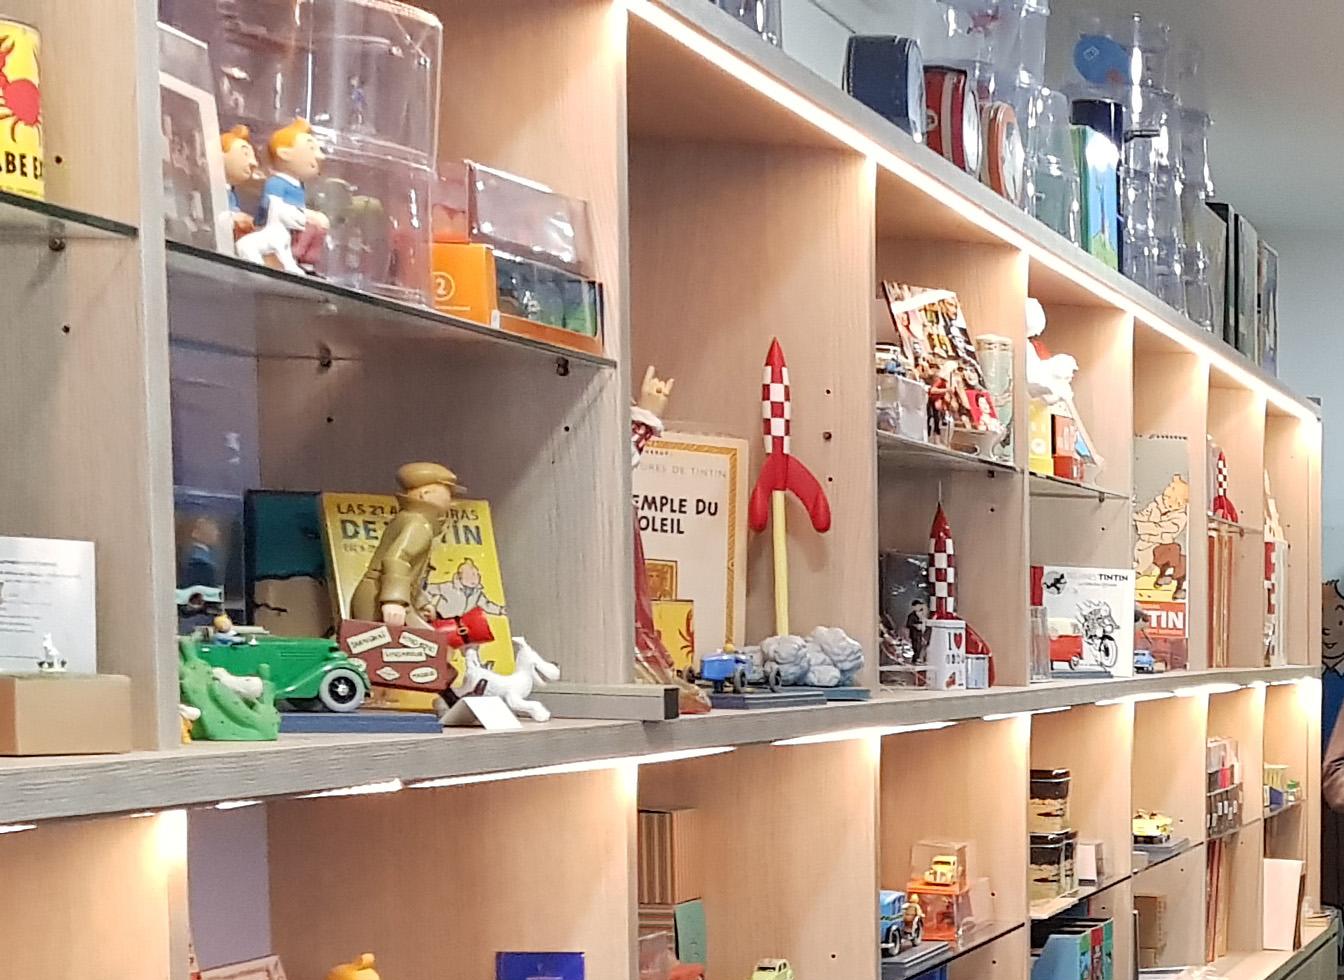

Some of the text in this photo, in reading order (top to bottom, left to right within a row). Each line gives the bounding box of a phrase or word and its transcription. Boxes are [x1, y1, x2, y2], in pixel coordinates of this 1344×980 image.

[0, 151, 28, 177] BE
[337, 503, 366, 516] LAS
[631, 494, 719, 517] EMPLE DU
[340, 519, 379, 541] DE
[638, 514, 685, 535] OLEIL
[1099, 573, 1129, 582] TINTIN
[1147, 610, 1185, 630] TIN
